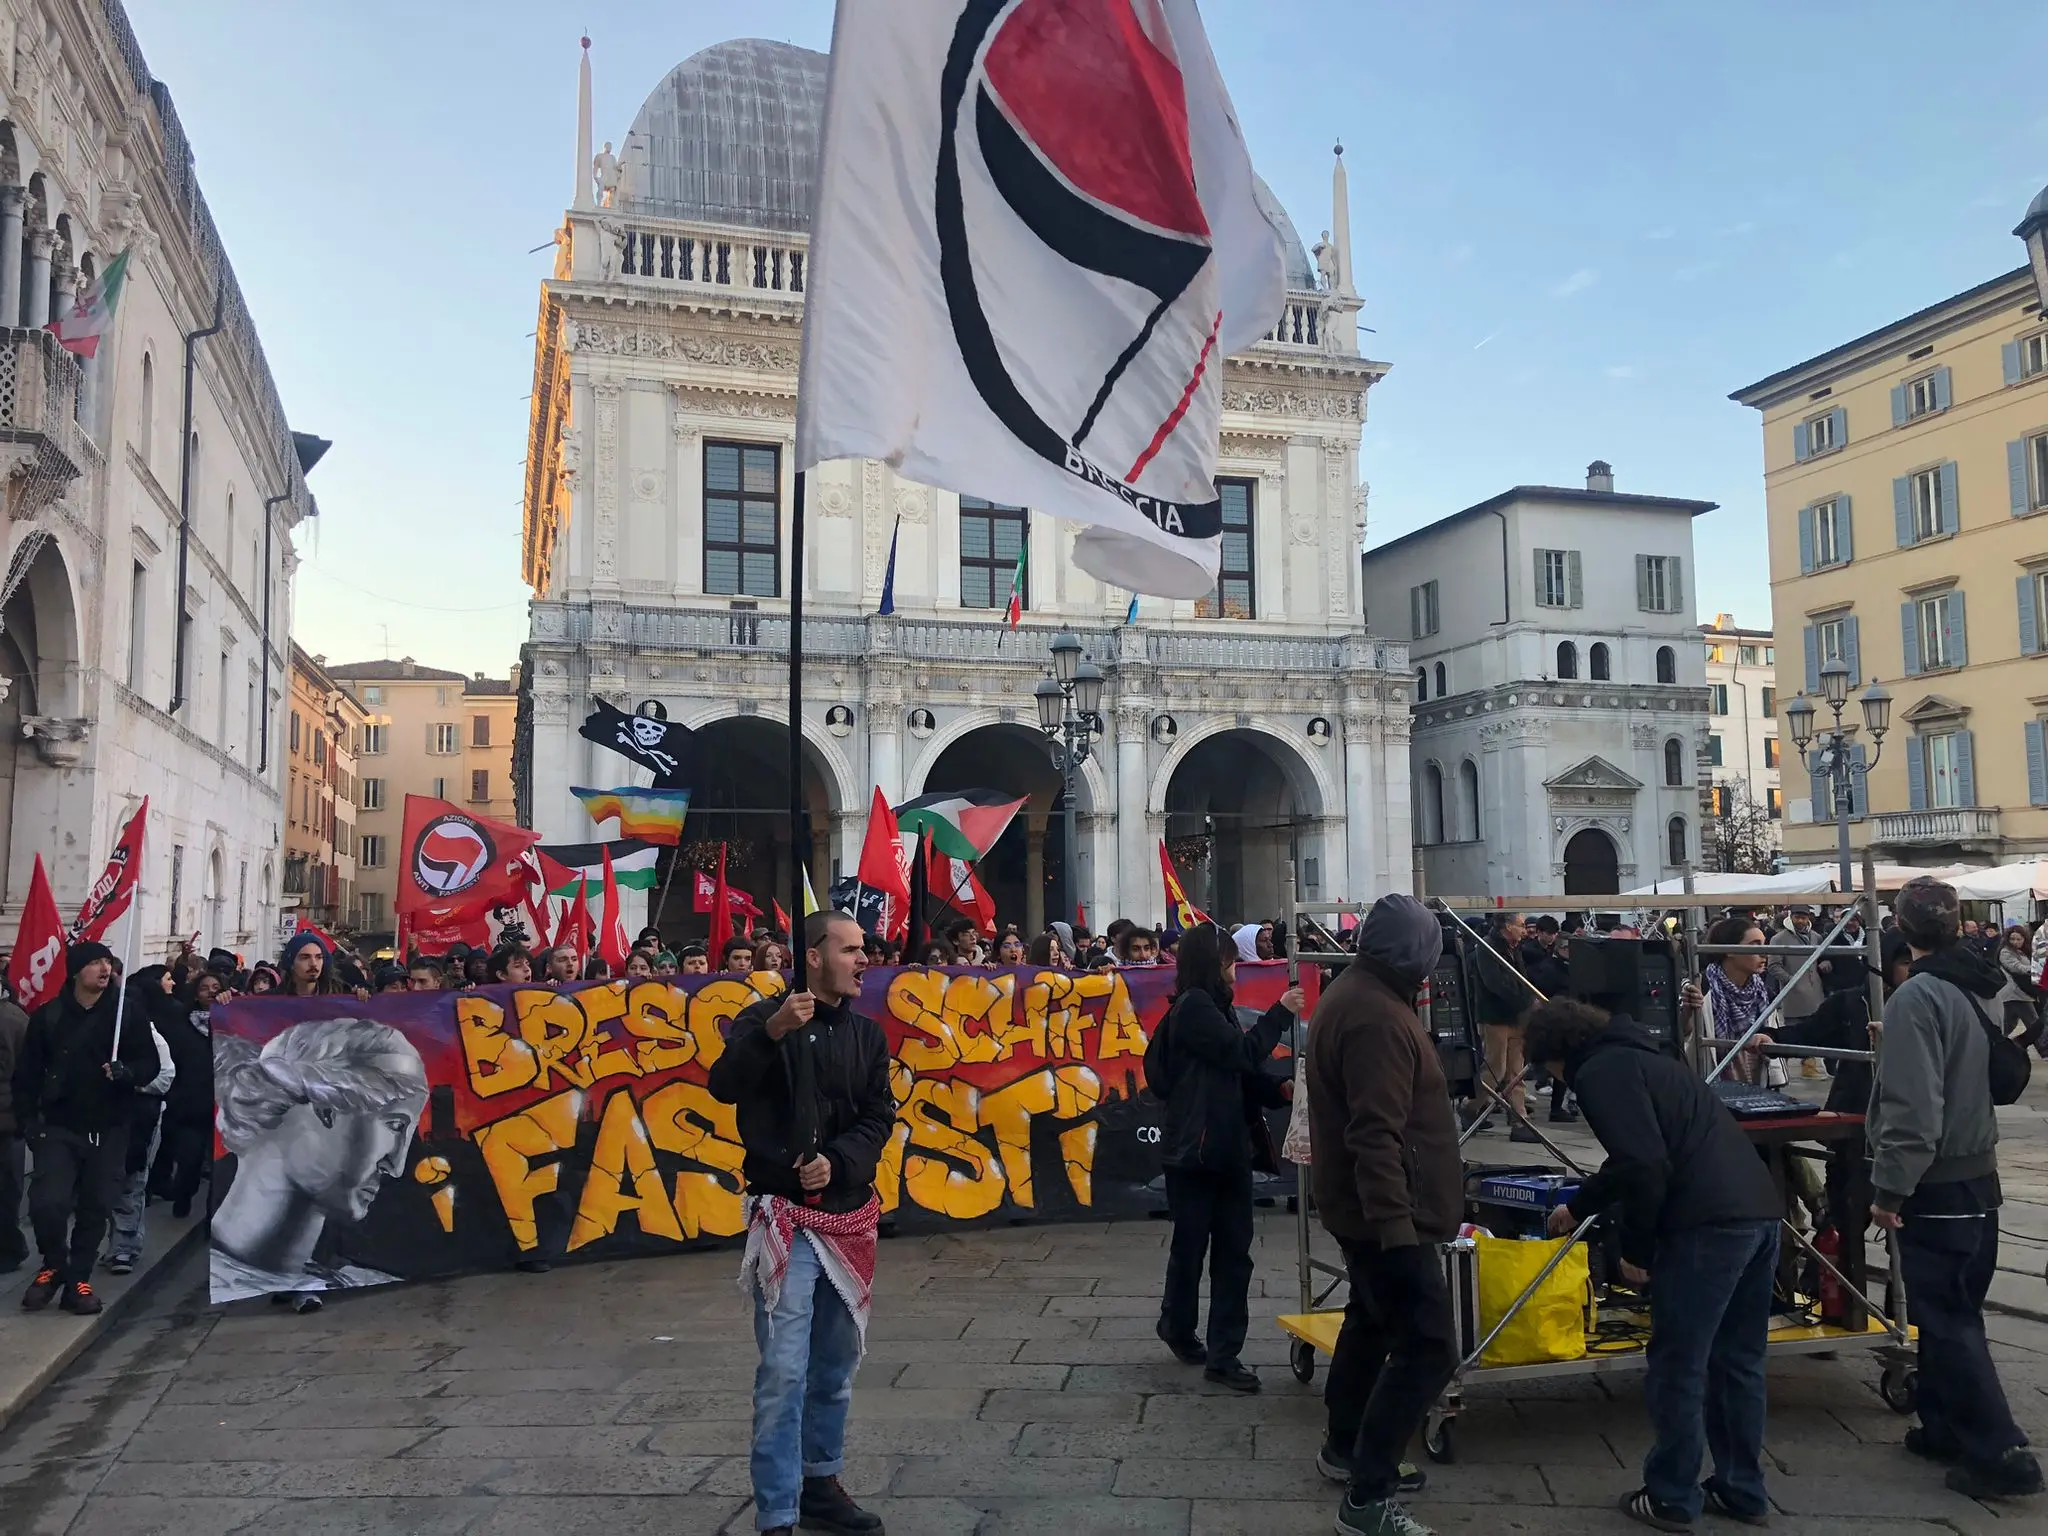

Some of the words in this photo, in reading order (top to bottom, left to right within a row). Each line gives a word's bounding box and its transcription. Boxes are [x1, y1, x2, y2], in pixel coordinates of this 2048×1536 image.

[1065, 445, 1184, 534] BRESCIA
[443, 814, 477, 828] AZIONE
[413, 871, 430, 891] ANTI
[456, 970, 787, 1099] BRESC
[1493, 1185, 1535, 1202] HYUNDAI
